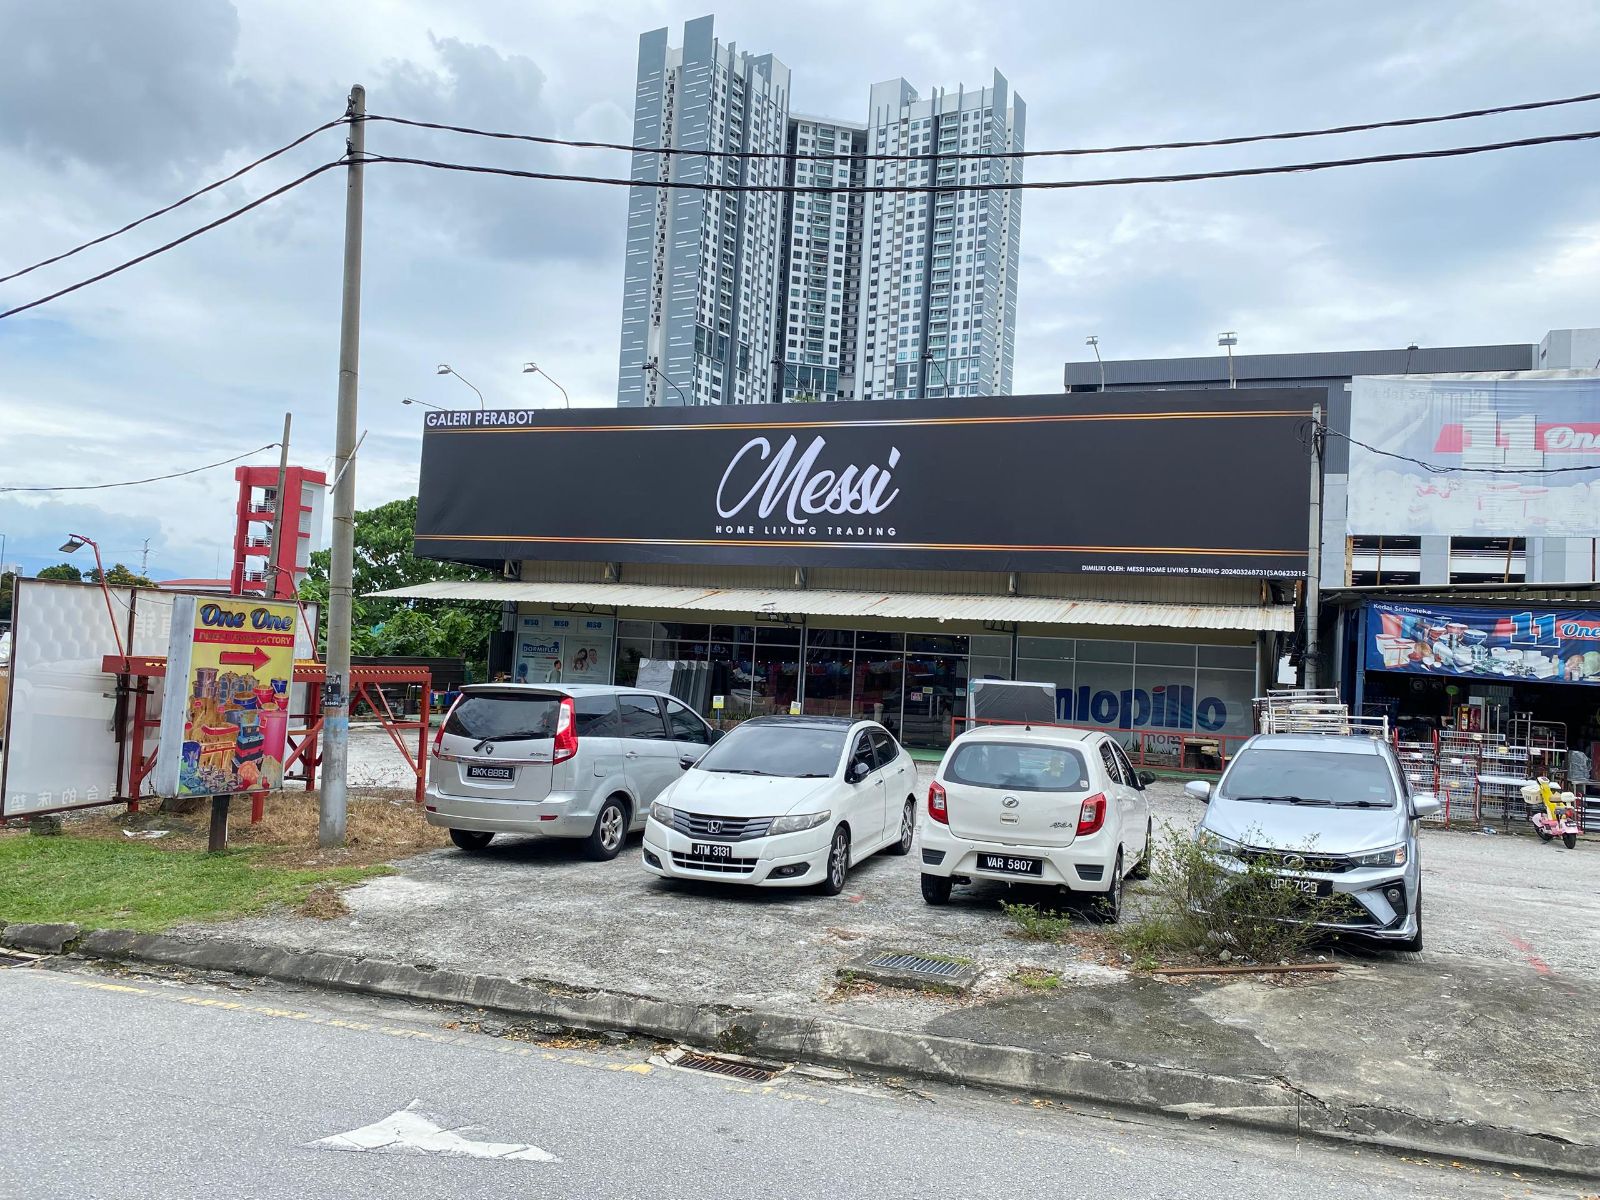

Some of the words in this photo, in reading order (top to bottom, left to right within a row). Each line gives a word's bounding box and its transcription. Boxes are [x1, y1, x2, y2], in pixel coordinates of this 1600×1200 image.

[426, 413, 471, 427] GALERI
[475, 411, 535, 425] PERABOT
[717, 435, 901, 524] Messi
[715, 525, 755, 534] HOME
[764, 526, 817, 535] LIVING
[827, 526, 897, 536] TRADING
[1373, 603, 1393, 611] Kedai
[200, 603, 246, 628] One
[250, 608, 293, 631] One
[1510, 612, 1560, 648] 11
[693, 844, 711, 855] JTM
[712, 845, 730, 857] 3131
[986, 856, 1004, 868] VAR
[1007, 858, 1033, 871] 5807
